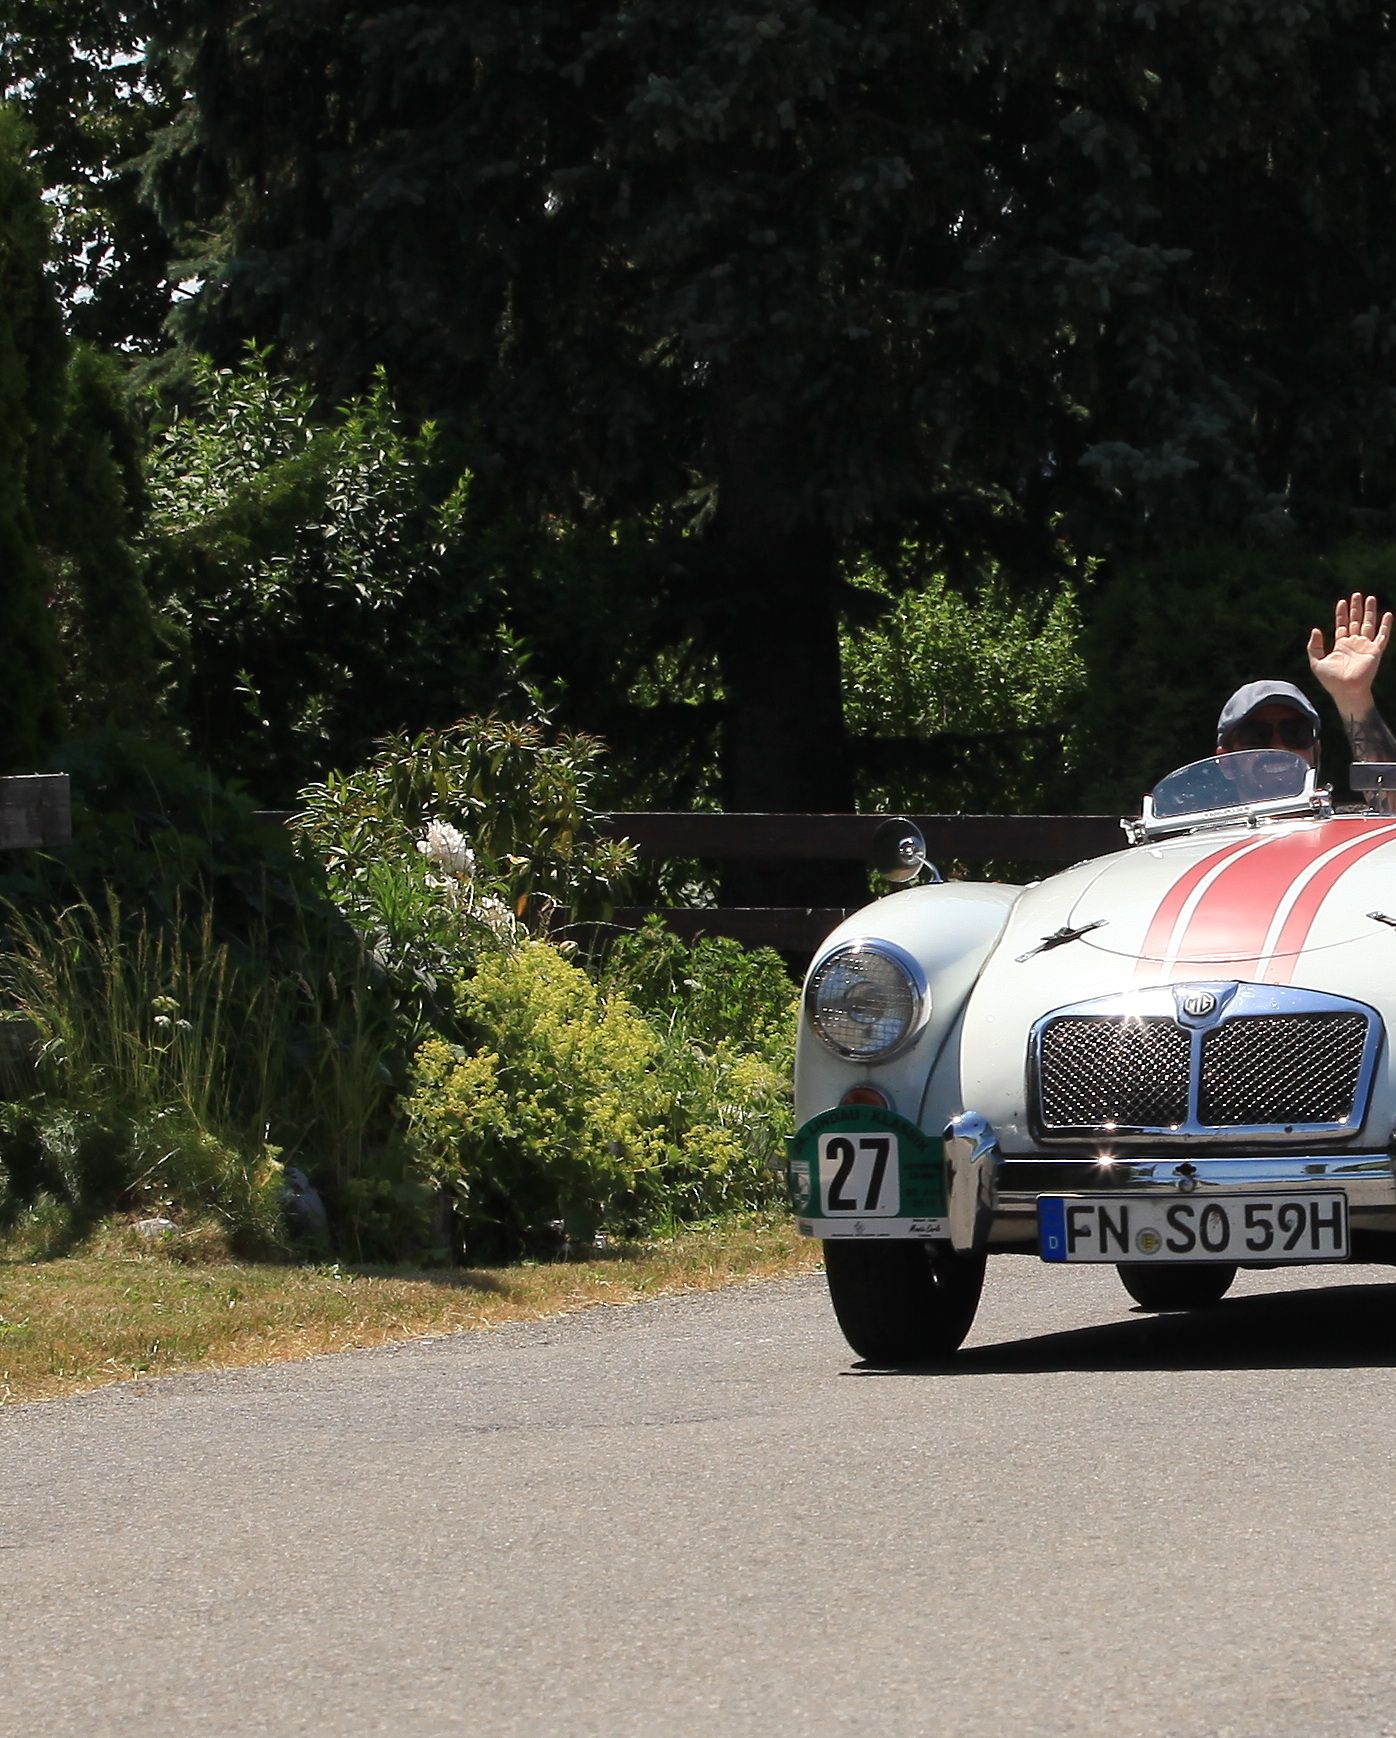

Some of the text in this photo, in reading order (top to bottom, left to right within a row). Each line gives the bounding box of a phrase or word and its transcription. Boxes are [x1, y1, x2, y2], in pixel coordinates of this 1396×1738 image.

[1186, 993, 1212, 1013] MG
[826, 1136, 890, 1211] 27
[1048, 1235, 1058, 1250] D
[1066, 1201, 1342, 1254] FN SO 59H
